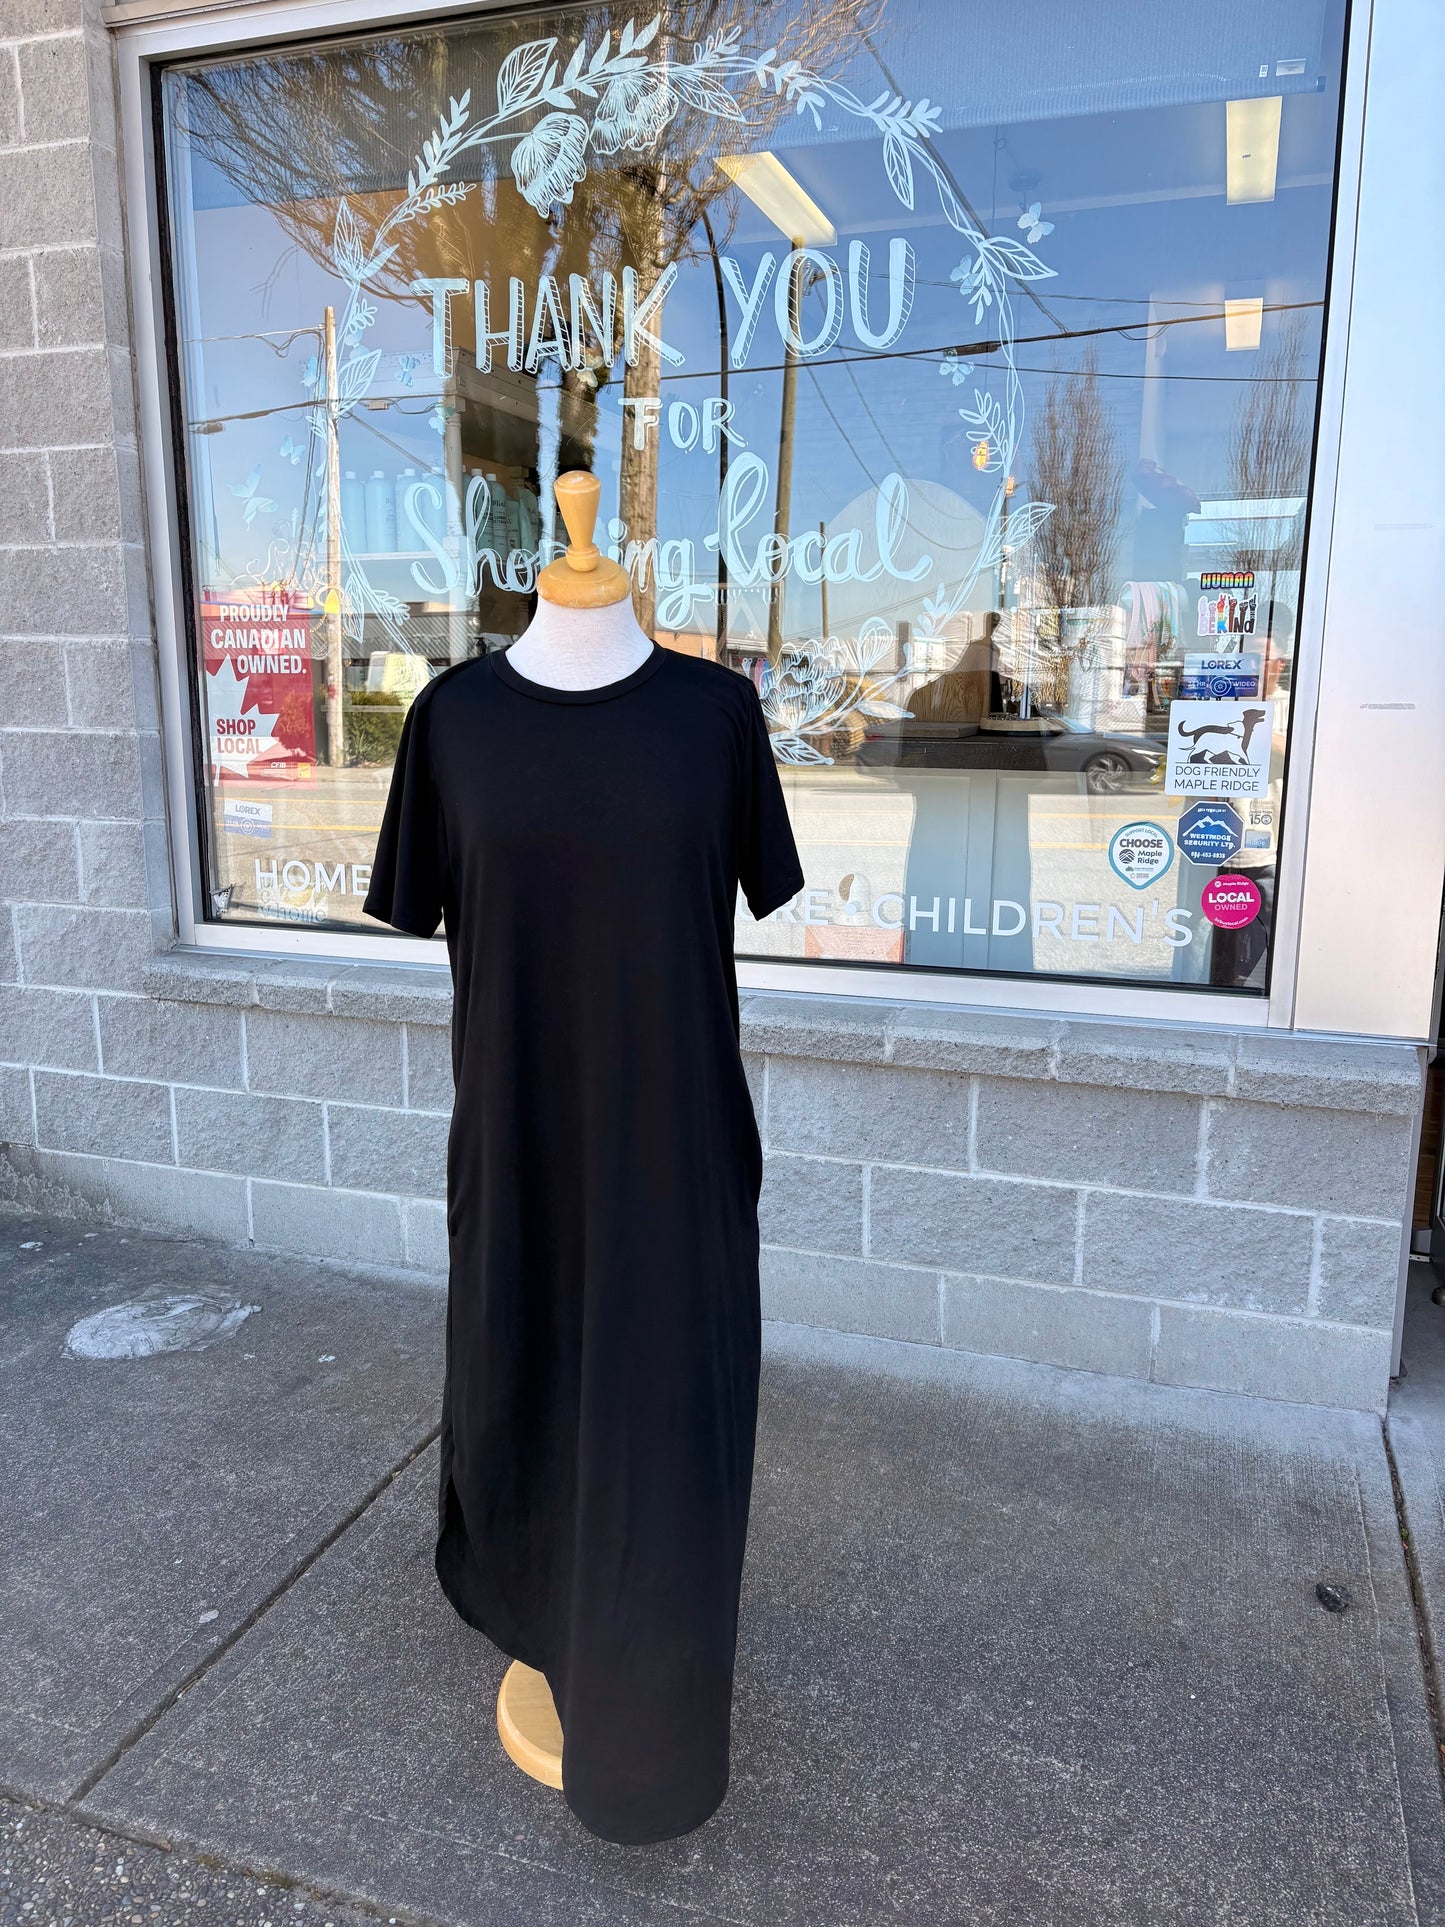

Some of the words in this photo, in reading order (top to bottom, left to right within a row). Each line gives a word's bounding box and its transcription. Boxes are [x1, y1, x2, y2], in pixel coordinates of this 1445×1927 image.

[409, 262, 687, 379] THANK
[721, 237, 916, 370] YOU
[618, 396, 748, 455] FOR
[1201, 572, 1255, 589] HUMAN
[220, 604, 289, 622] PROUDLY
[210, 628, 306, 649] CANADIAN
[237, 654, 307, 674] OWNED.
[1201, 660, 1242, 669] LOREX
[216, 719, 256, 735] SHOP
[217, 737, 263, 755] LOCAL
[1175, 766, 1201, 775] DOG
[1204, 767, 1260, 777] FRIENDLY
[1174, 779, 1218, 790] MAPLE
[1221, 780, 1259, 791] RIDGE
[235, 804, 261, 815] LOREX
[1119, 838, 1163, 848] CHOOSE
[1138, 857, 1160, 865] Ridge
[254, 859, 372, 896] HOME
[1208, 892, 1255, 903] LOCAL
[873, 893, 1194, 948] CHILDREN'S
